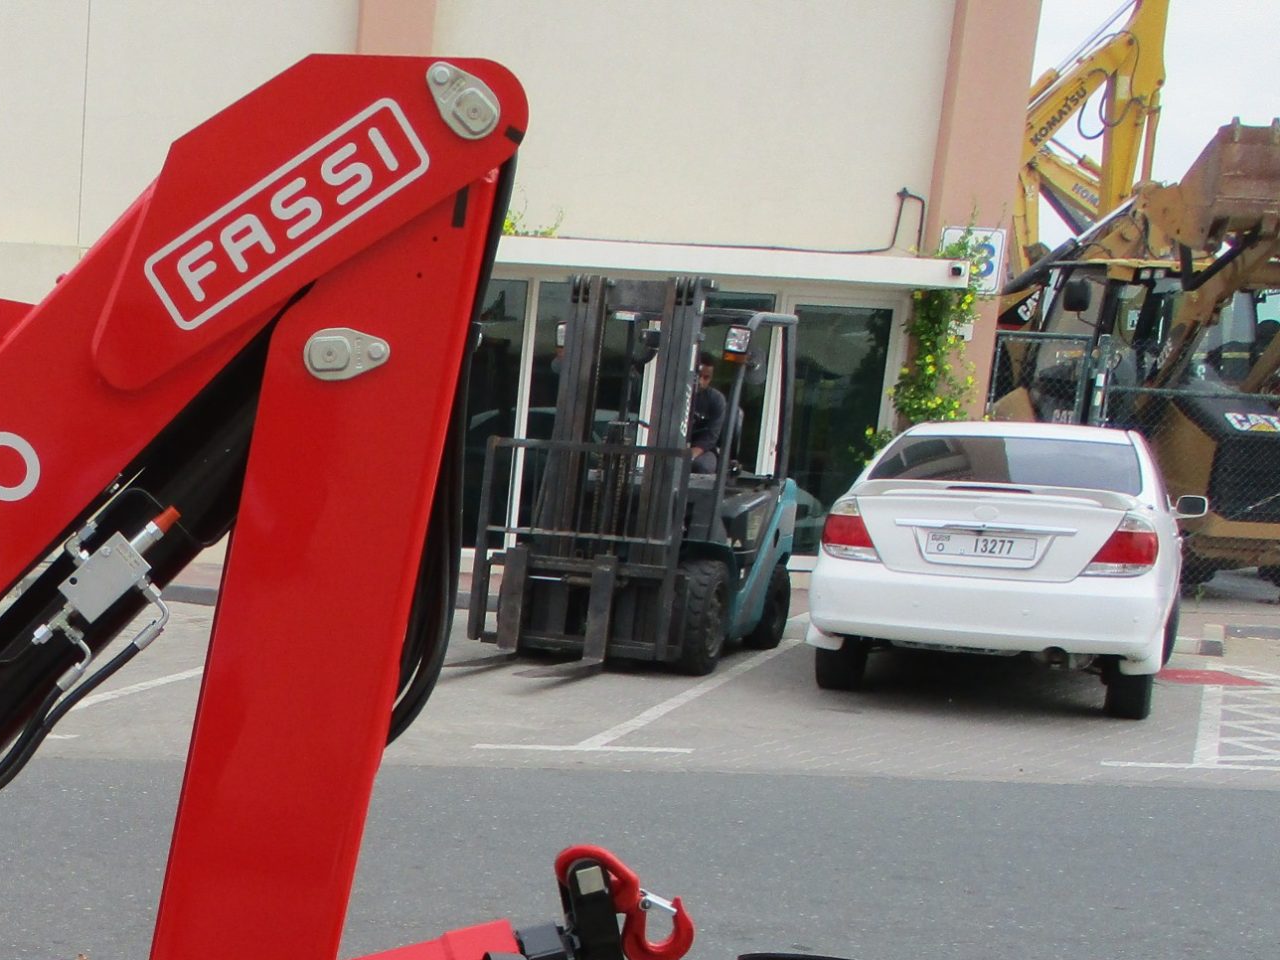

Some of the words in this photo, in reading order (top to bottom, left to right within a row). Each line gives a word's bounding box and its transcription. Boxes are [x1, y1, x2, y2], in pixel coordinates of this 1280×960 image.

[1030, 86, 1087, 147] KOMATSU
[177, 126, 399, 302] FASSI
[973, 538, 1015, 555] 13277
